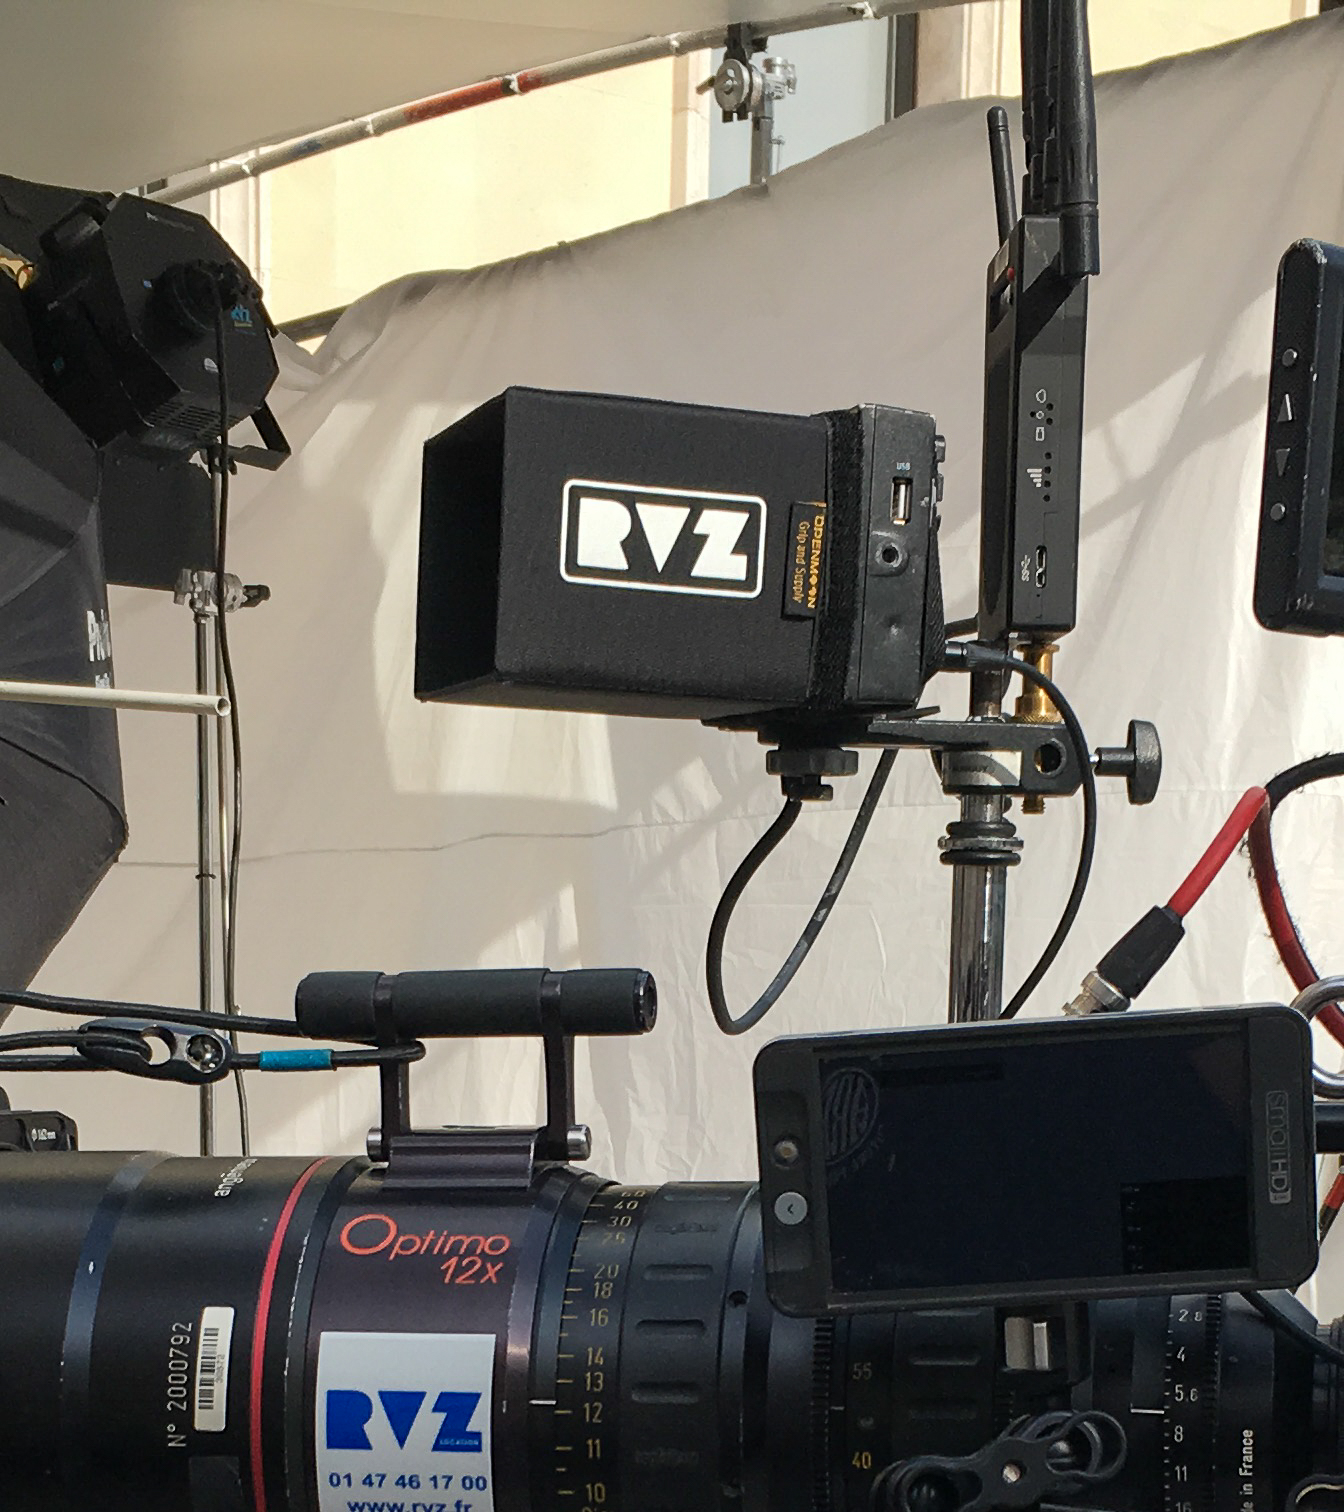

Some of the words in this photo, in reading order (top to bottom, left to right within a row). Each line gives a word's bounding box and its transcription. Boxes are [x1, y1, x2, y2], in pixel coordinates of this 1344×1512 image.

[576, 496, 751, 582] RVZ
[796, 520, 811, 544] Grip
[795, 544, 807, 566] and
[792, 567, 807, 604] Supply
[613, 1200, 639, 1210] 40
[607, 1216, 632, 1227] 30
[340, 1213, 511, 1261] Optimo
[440, 1255, 504, 1284] 12x
[593, 1264, 619, 1279] 20
[593, 1281, 613, 1299] 18
[589, 1308, 609, 1326] 16
[1178, 1308, 1203, 1322] 2.8
[586, 1346, 604, 1366] 14
[1176, 1346, 1185, 1362] 4
[166, 1321, 193, 1411] 2000792
[584, 1371, 604, 1392] 13
[1174, 1384, 1198, 1403] 5.6
[326, 1390, 483, 1452] RVZ
[583, 1402, 603, 1424] 12
[1173, 1425, 1184, 1442] 8
[586, 1438, 601, 1459] 11
[1238, 1429, 1254, 1476] France
[851, 1451, 872, 1470] 40
[328, 1472, 353, 1488] 01
[361, 1473, 387, 1488] 47
[394, 1474, 421, 1489] 46
[429, 1475, 454, 1490] 17
[461, 1476, 488, 1491] 00
[1174, 1464, 1187, 1482] 11
[585, 1482, 606, 1503] 10
[1239, 1483, 1253, 1496] in
